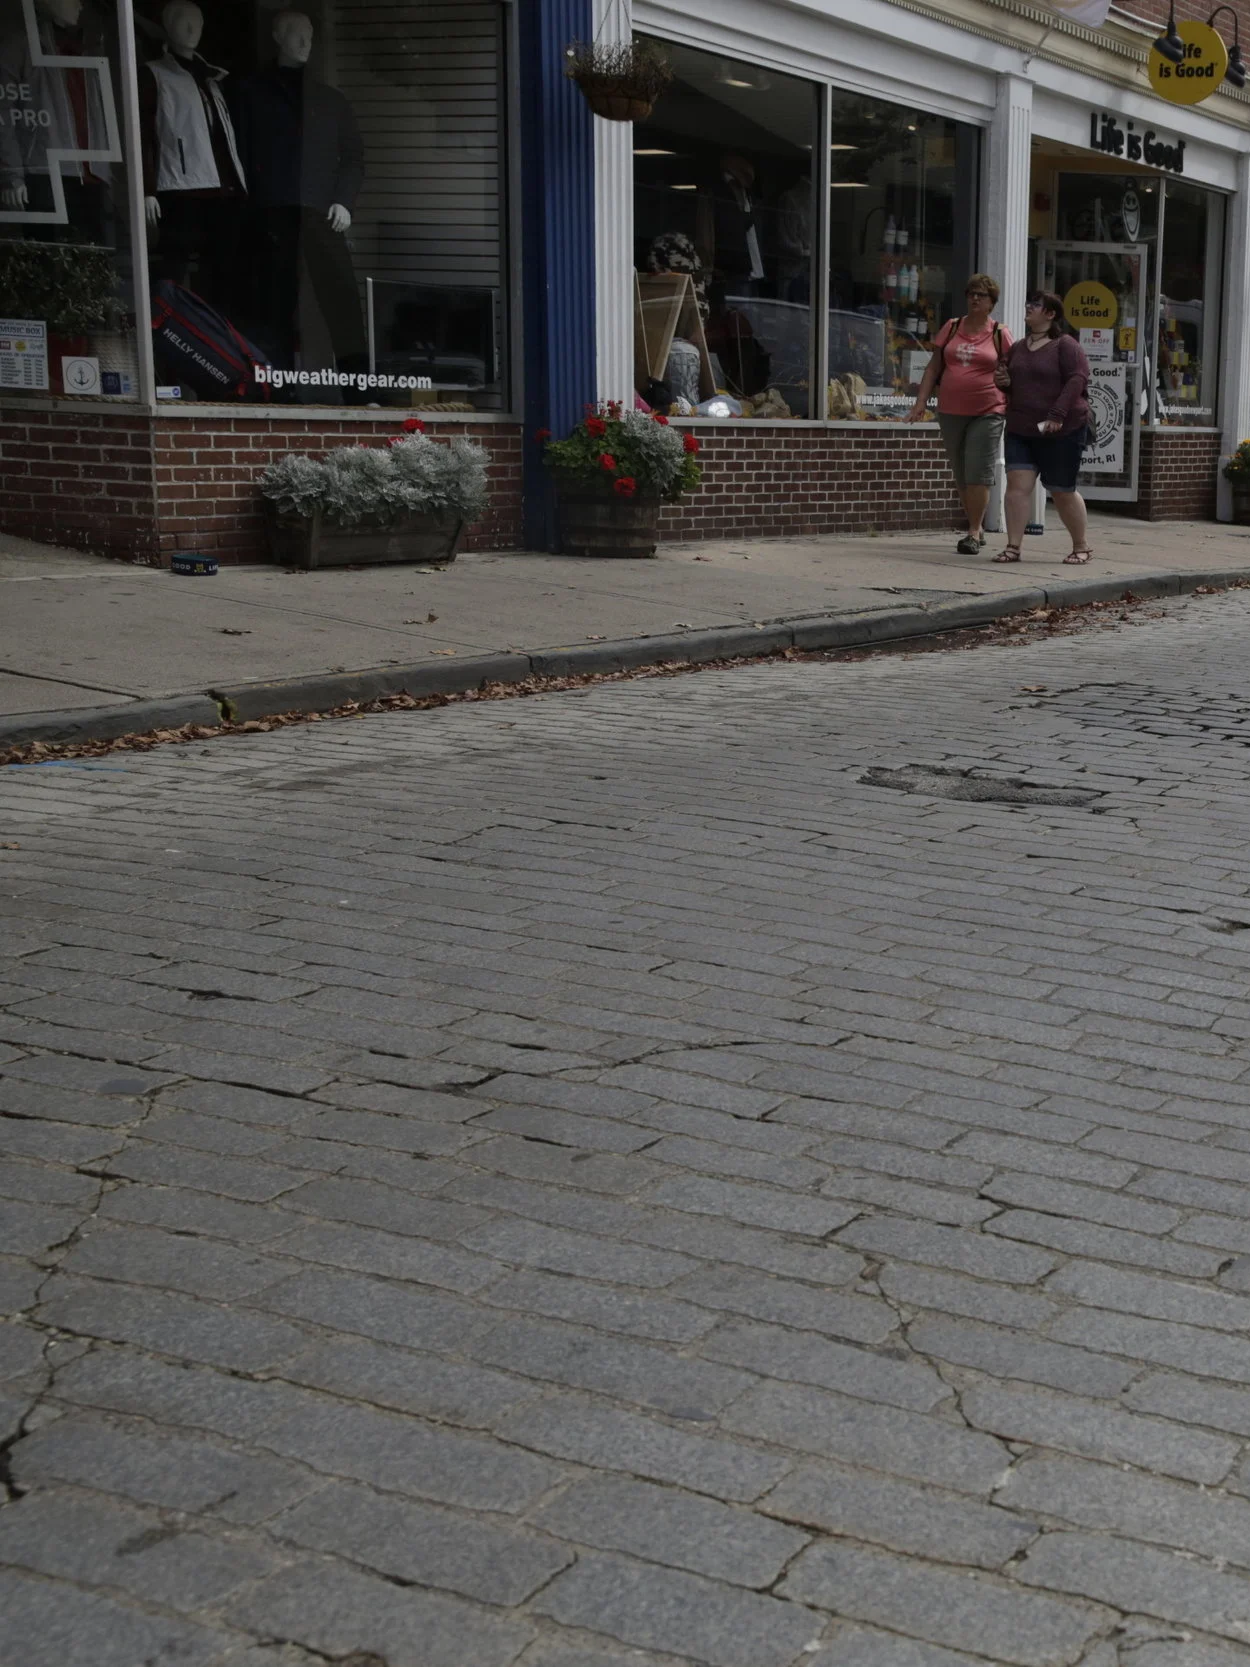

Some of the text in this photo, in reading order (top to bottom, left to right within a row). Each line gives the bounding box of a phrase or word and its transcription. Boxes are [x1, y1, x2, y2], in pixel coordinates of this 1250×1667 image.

[1183, 43, 1201, 58] ife
[1159, 64, 1214, 77] is Good
[9, 108, 52, 127] PRO
[1090, 112, 1184, 173] Life is Good
[1080, 295, 1101, 306] Life
[1071, 307, 1109, 318] is Good
[26, 327, 42, 335] BOX
[163, 328, 230, 385] HELLY HANSEN
[254, 365, 432, 391] bigweathergear.com
[1106, 454, 1116, 463] RI
